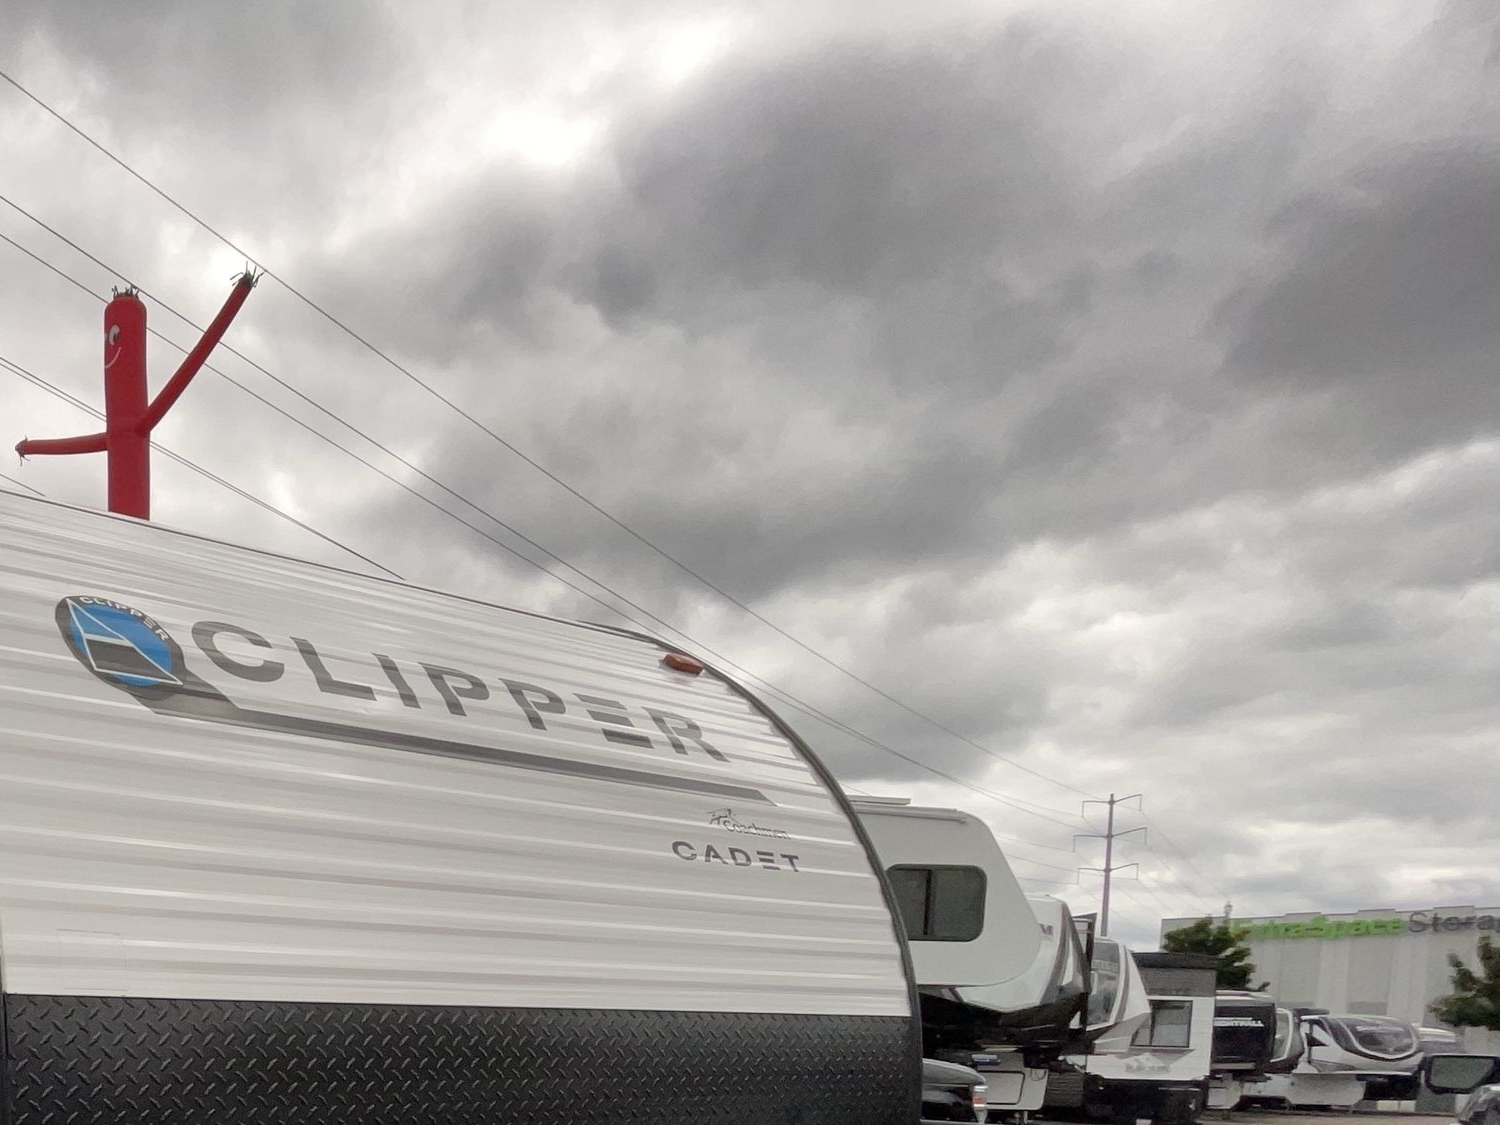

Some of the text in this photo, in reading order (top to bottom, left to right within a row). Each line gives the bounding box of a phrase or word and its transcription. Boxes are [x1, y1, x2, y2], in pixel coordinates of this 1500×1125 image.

[79, 596, 170, 641] CLIPPER
[190, 620, 731, 763] CLIPPER
[671, 840, 800, 873] CADET
[1409, 911, 1500, 933] Stora
